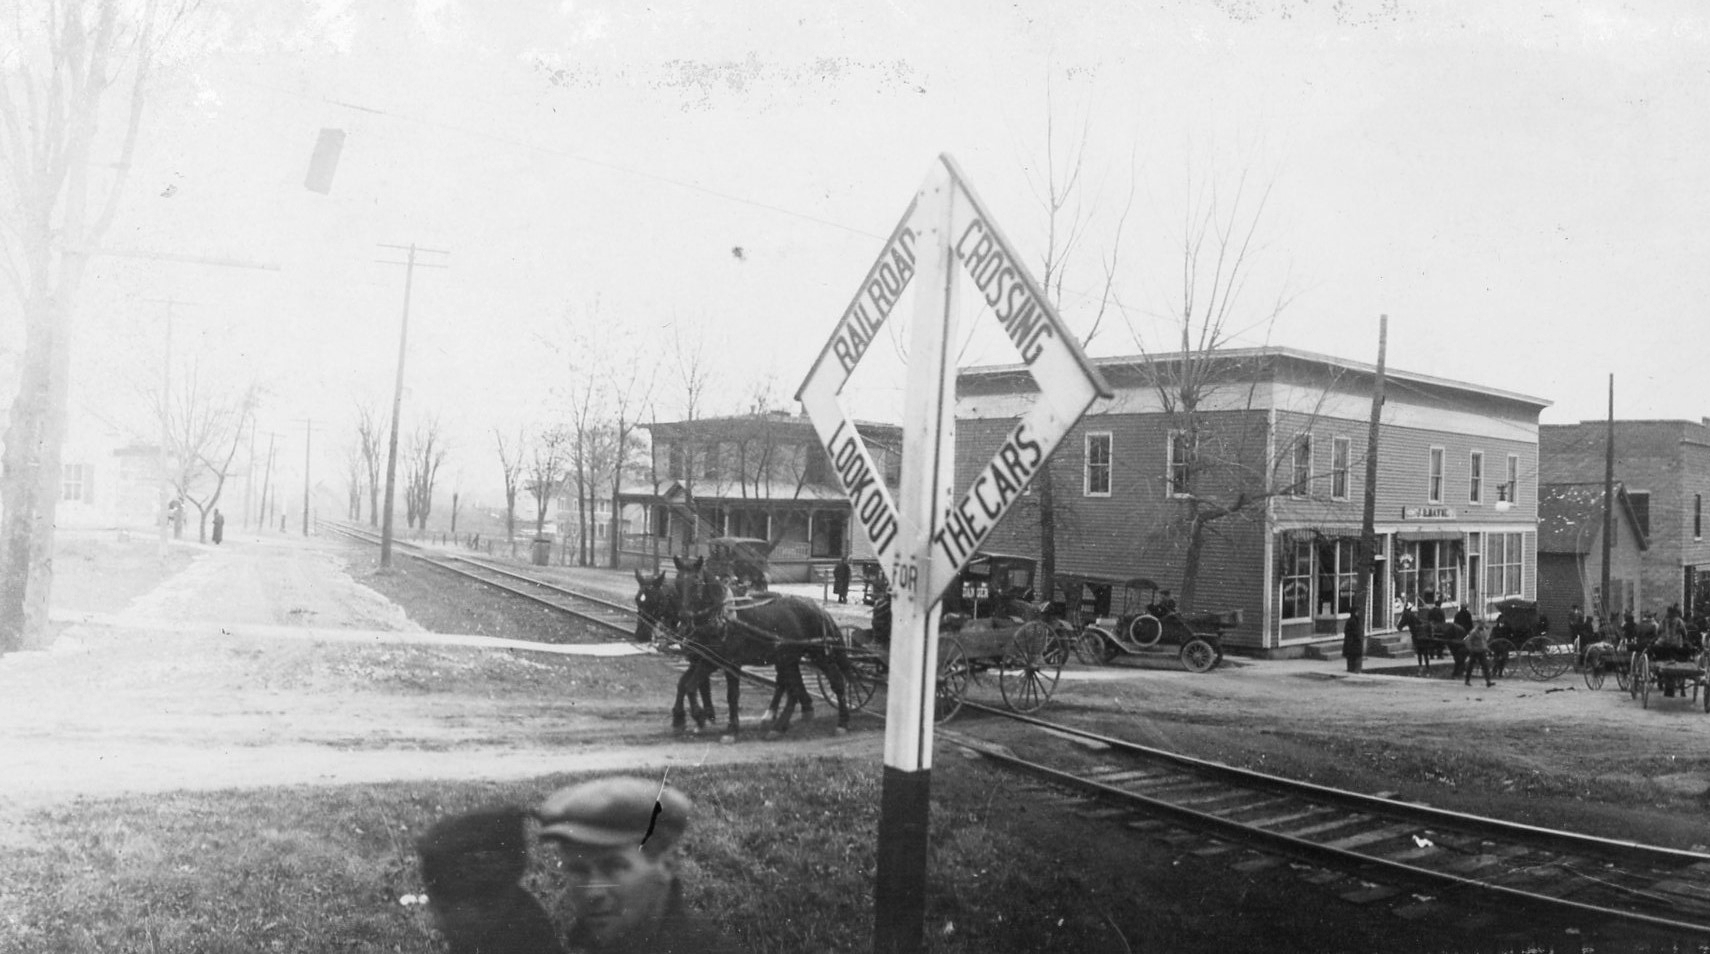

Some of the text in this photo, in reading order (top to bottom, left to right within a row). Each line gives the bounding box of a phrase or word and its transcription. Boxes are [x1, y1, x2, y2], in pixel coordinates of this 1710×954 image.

[833, 226, 916, 376] RAILROAD
[955, 217, 1053, 366] CROSSING
[934, 424, 1042, 570] THE CARS
[892, 562, 918, 593] FOR
